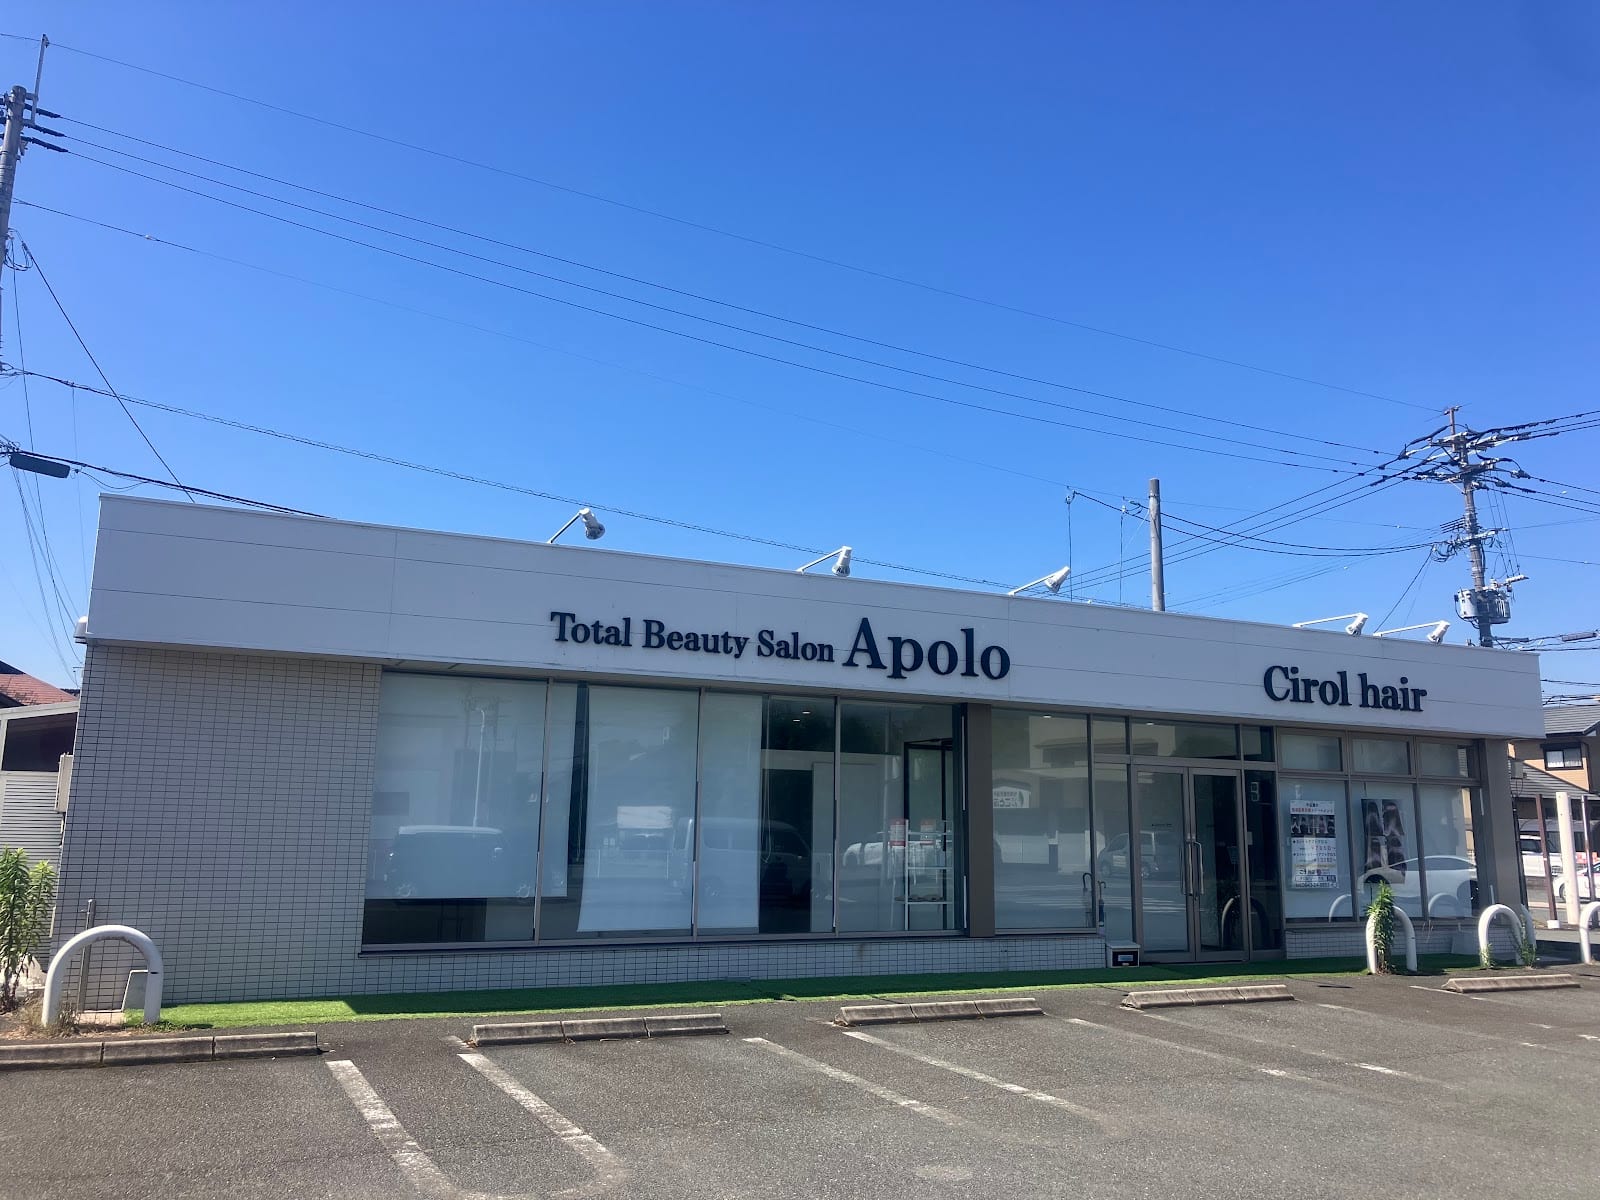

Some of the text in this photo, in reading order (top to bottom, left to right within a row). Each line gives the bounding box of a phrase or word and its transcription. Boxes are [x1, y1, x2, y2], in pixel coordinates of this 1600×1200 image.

[550, 611, 1011, 681] Total Beauty Salon Apolo
[1263, 665, 1428, 712] Cirol hair
